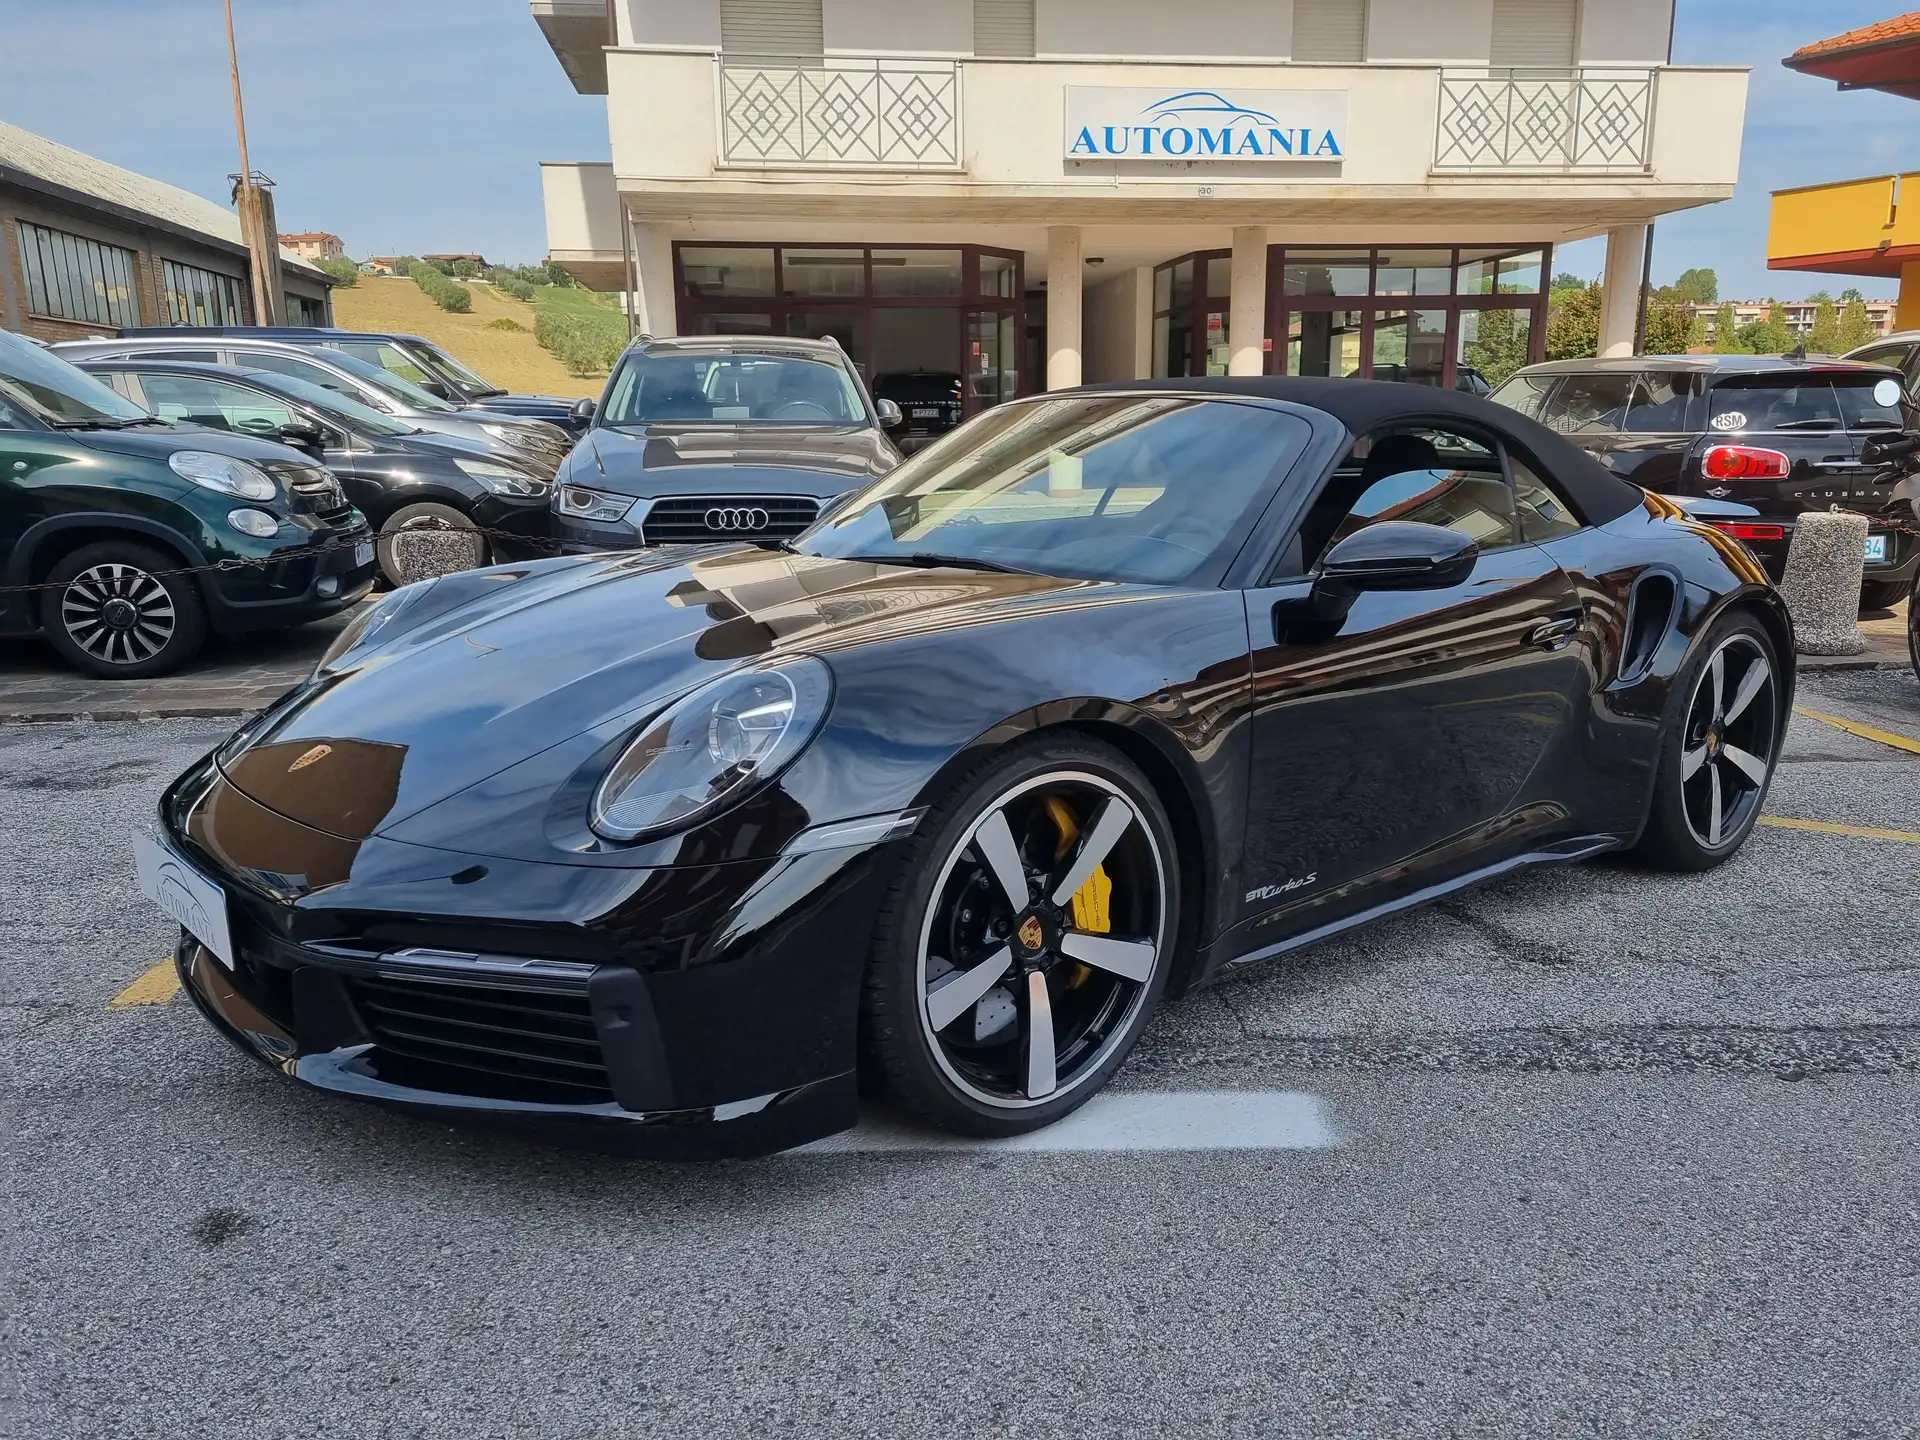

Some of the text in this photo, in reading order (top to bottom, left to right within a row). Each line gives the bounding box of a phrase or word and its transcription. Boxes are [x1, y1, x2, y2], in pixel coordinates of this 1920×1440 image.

[1070, 126, 1343, 156] AUTOMANIA
[1200, 187, 1212, 195] 30
[1715, 415, 1743, 427] RSM
[156, 884, 218, 951] AUTOMANIA
